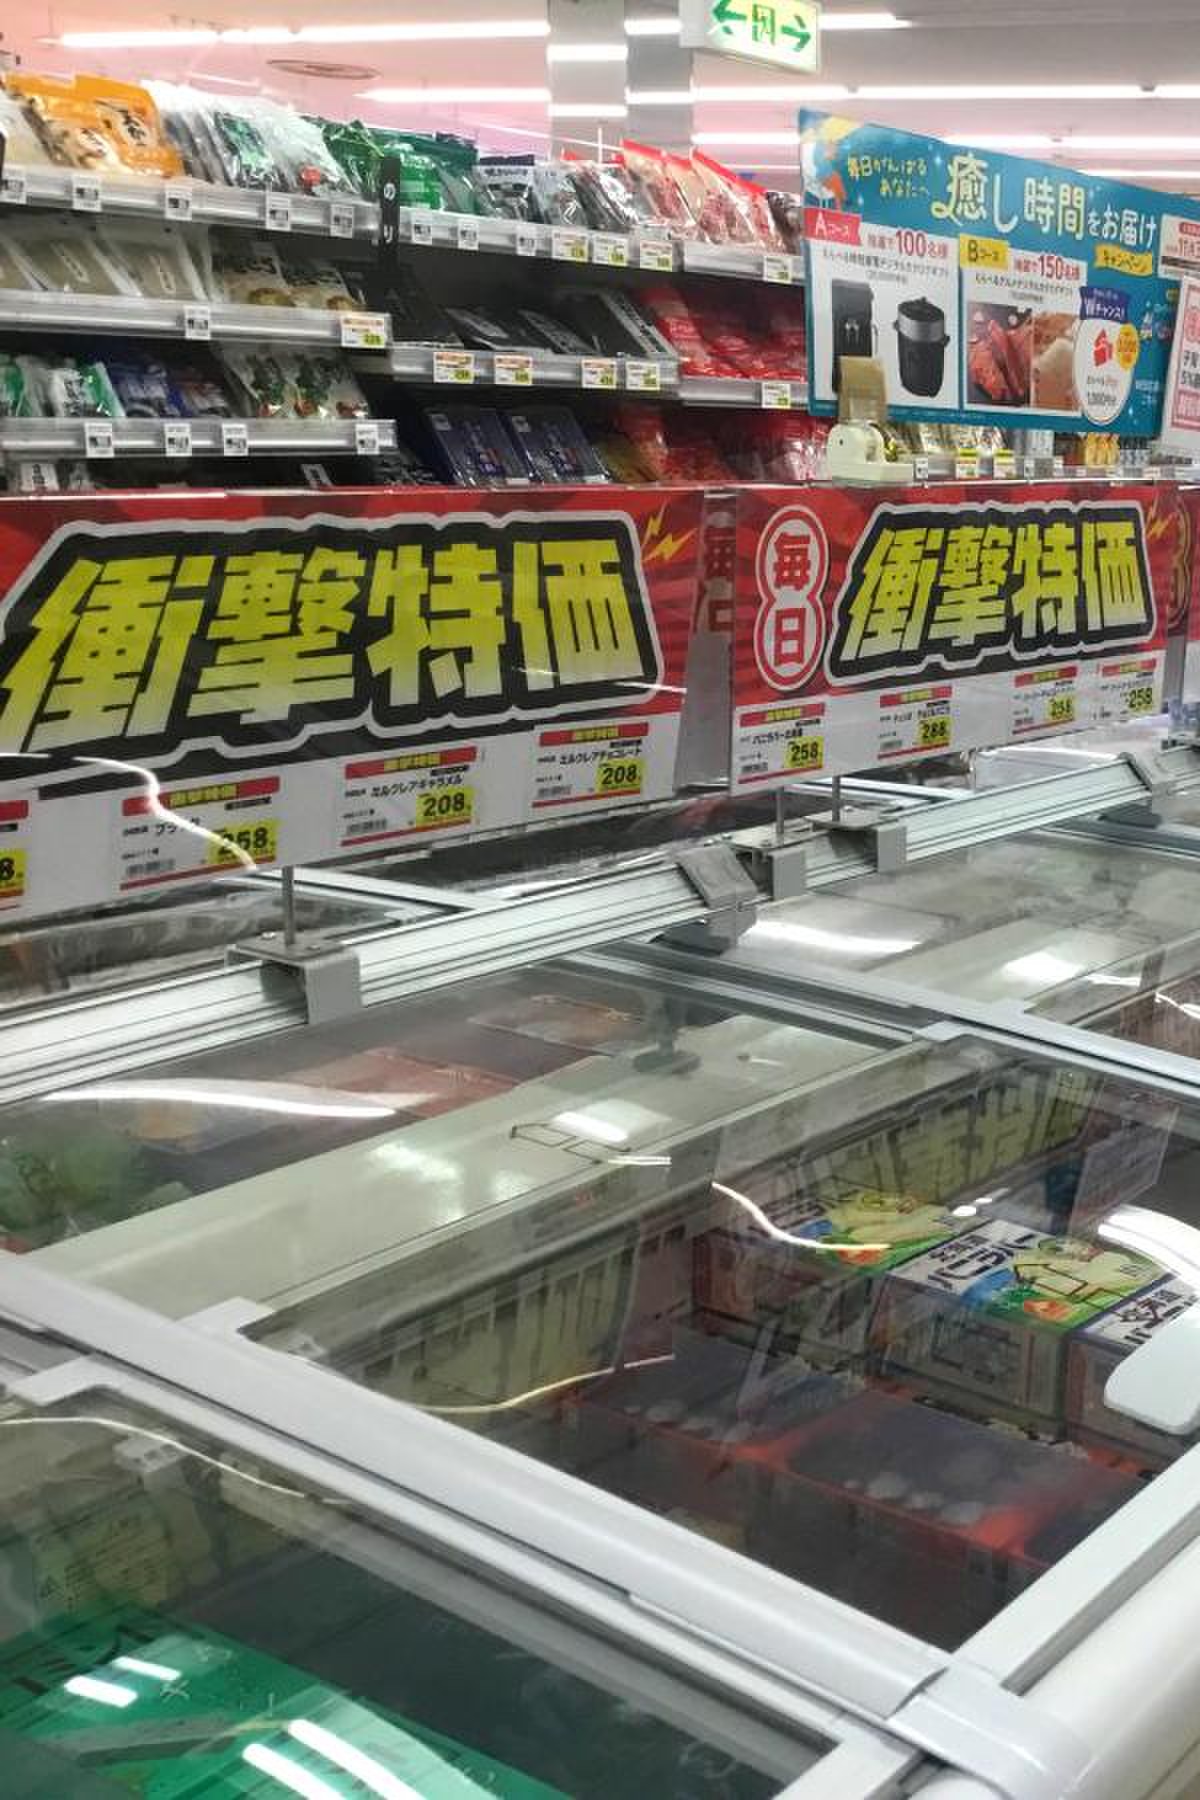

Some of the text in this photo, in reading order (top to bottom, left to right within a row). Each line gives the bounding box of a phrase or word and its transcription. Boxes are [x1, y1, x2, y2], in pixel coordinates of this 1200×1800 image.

[847, 154, 929, 181] 毎日がんばる
[879, 177, 929, 199] あなたへ
[931, 151, 1157, 249] 癒し時間をお届け
[815, 210, 850, 238] Aコース
[967, 239, 1000, 262] Bコース
[772, 532, 813, 668] 毎日
[840, 521, 1149, 664] 衝撃特価
[0, 539, 643, 754] 衝撃特価
[791, 741, 820, 763] 258
[602, 764, 638, 786] 208
[422, 792, 466, 818] 208
